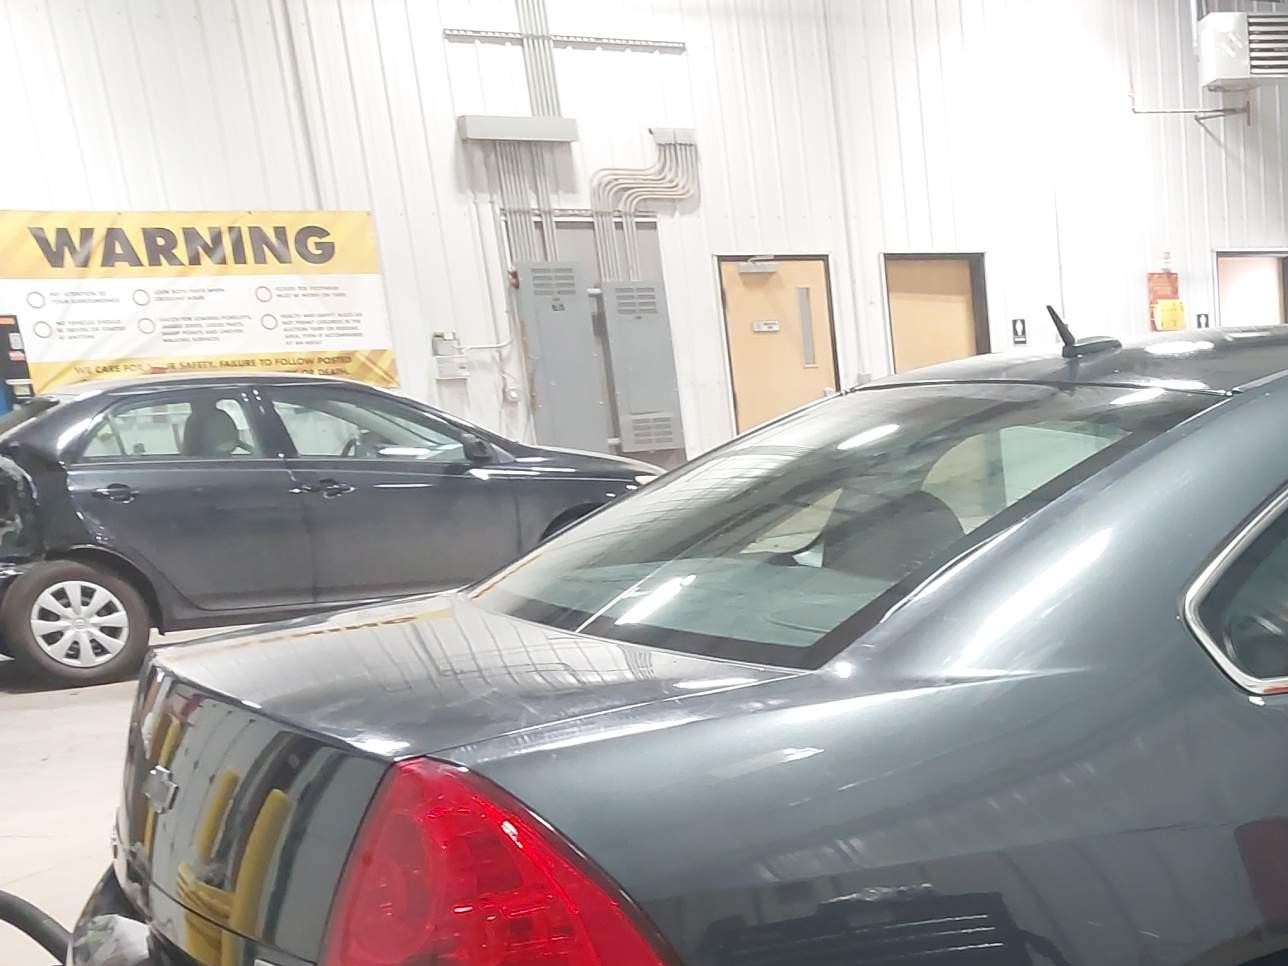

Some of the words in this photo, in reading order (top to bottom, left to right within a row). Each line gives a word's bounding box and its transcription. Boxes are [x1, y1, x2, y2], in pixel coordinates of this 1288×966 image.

[29, 225, 336, 268] WARNING
[95, 365, 120, 374] CARE
[220, 360, 256, 368] FAILURE
[260, 359, 272, 367] TO
[276, 357, 314, 366] FOLLOW
[317, 356, 352, 365] POSTED
